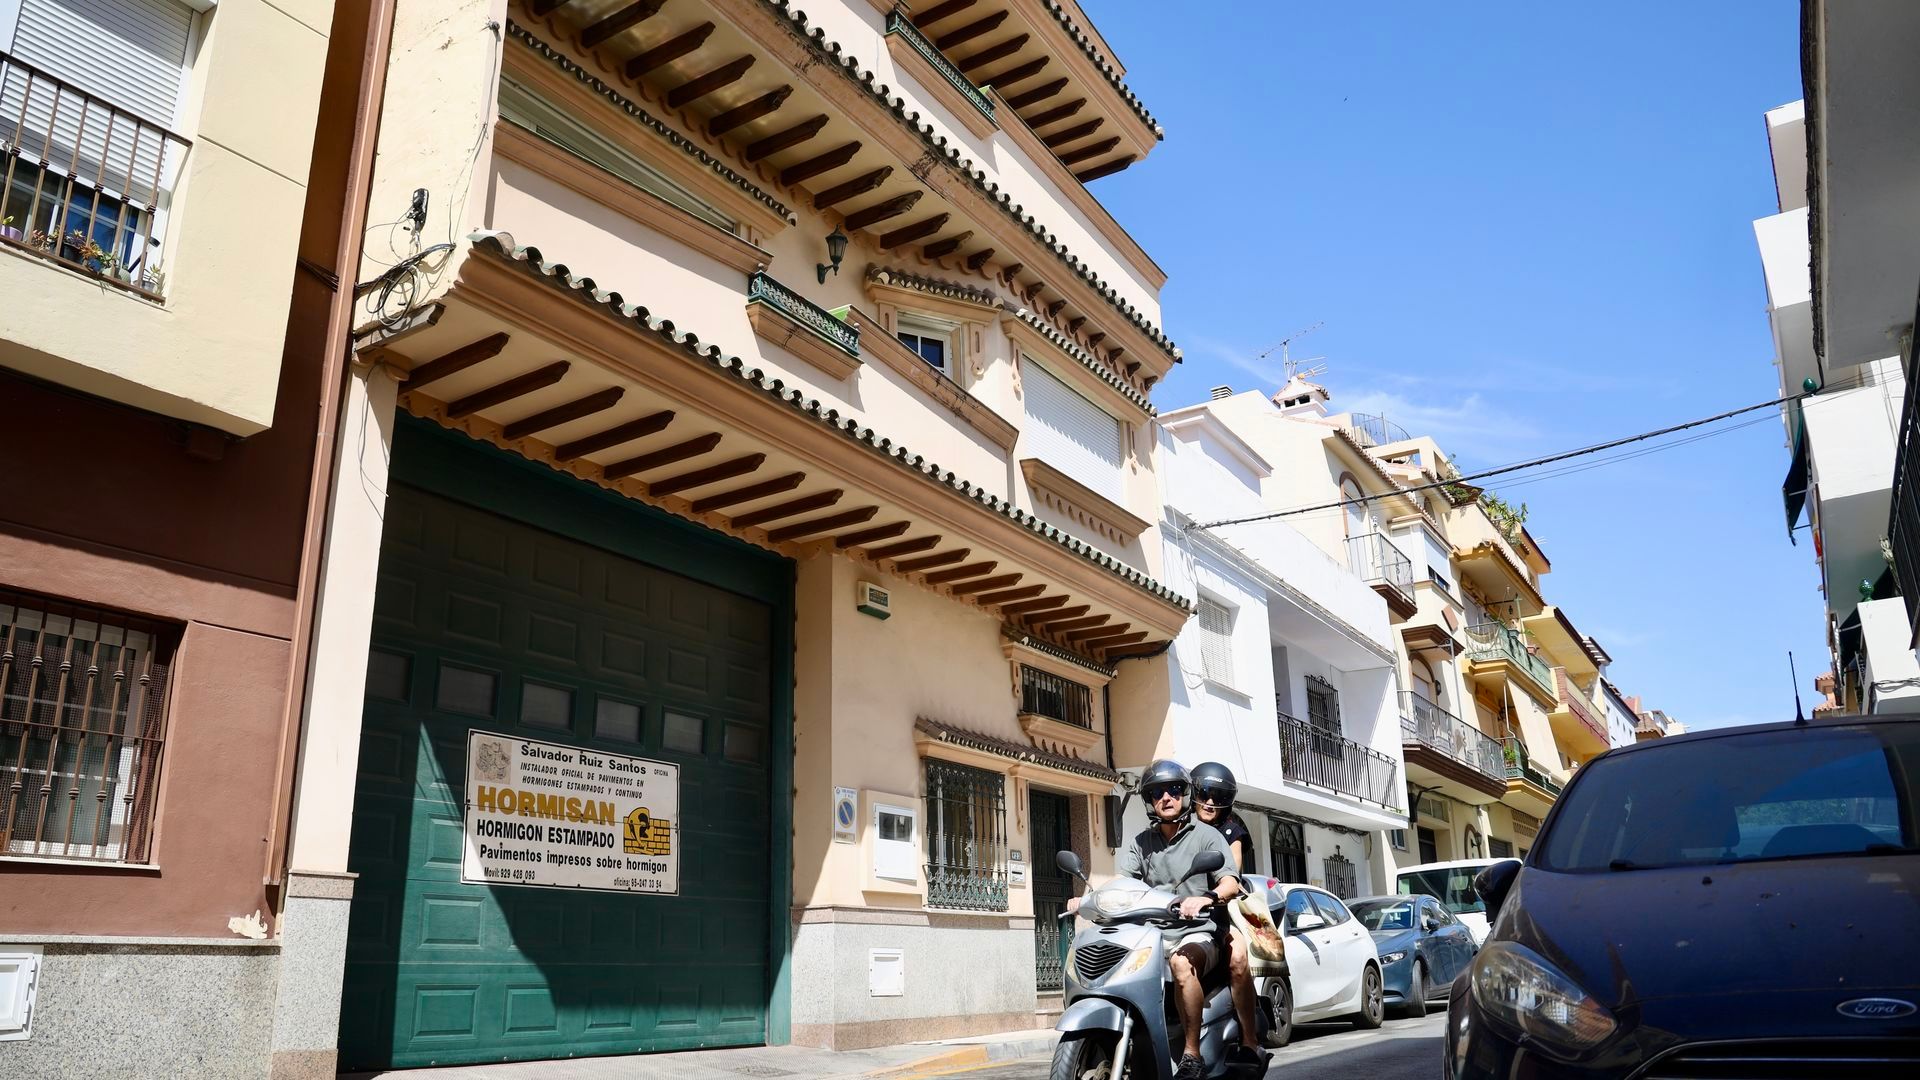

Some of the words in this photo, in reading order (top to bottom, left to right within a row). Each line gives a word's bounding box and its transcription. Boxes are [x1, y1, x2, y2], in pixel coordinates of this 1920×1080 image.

[521, 744, 573, 763] Salvador
[579, 755, 603, 768] Ruiz
[609, 759, 647, 775] Santos
[520, 762, 558, 775] INSTALADOR
[561, 768, 583, 779] OFICIAL
[587, 772, 595, 780] DE
[598, 774, 633, 786] PAVIMENTOS
[636, 779, 644, 787] EN
[522, 775, 562, 788] HORMIGONES
[567, 782, 604, 794] ESTAMPADOS
[607, 787, 612, 796] Y
[615, 788, 643, 799] CONTINUO
[478, 785, 615, 826] HORMISAN
[477, 819, 542, 841] HORMIGON
[548, 827, 614, 848] ESTAMPADO
[480, 843, 542, 862] Pavimentos
[546, 850, 592, 867] impresos
[596, 855, 622, 869] sobre
[626, 857, 667, 875] hormigon
[1854, 1001, 1898, 1014] Ford
